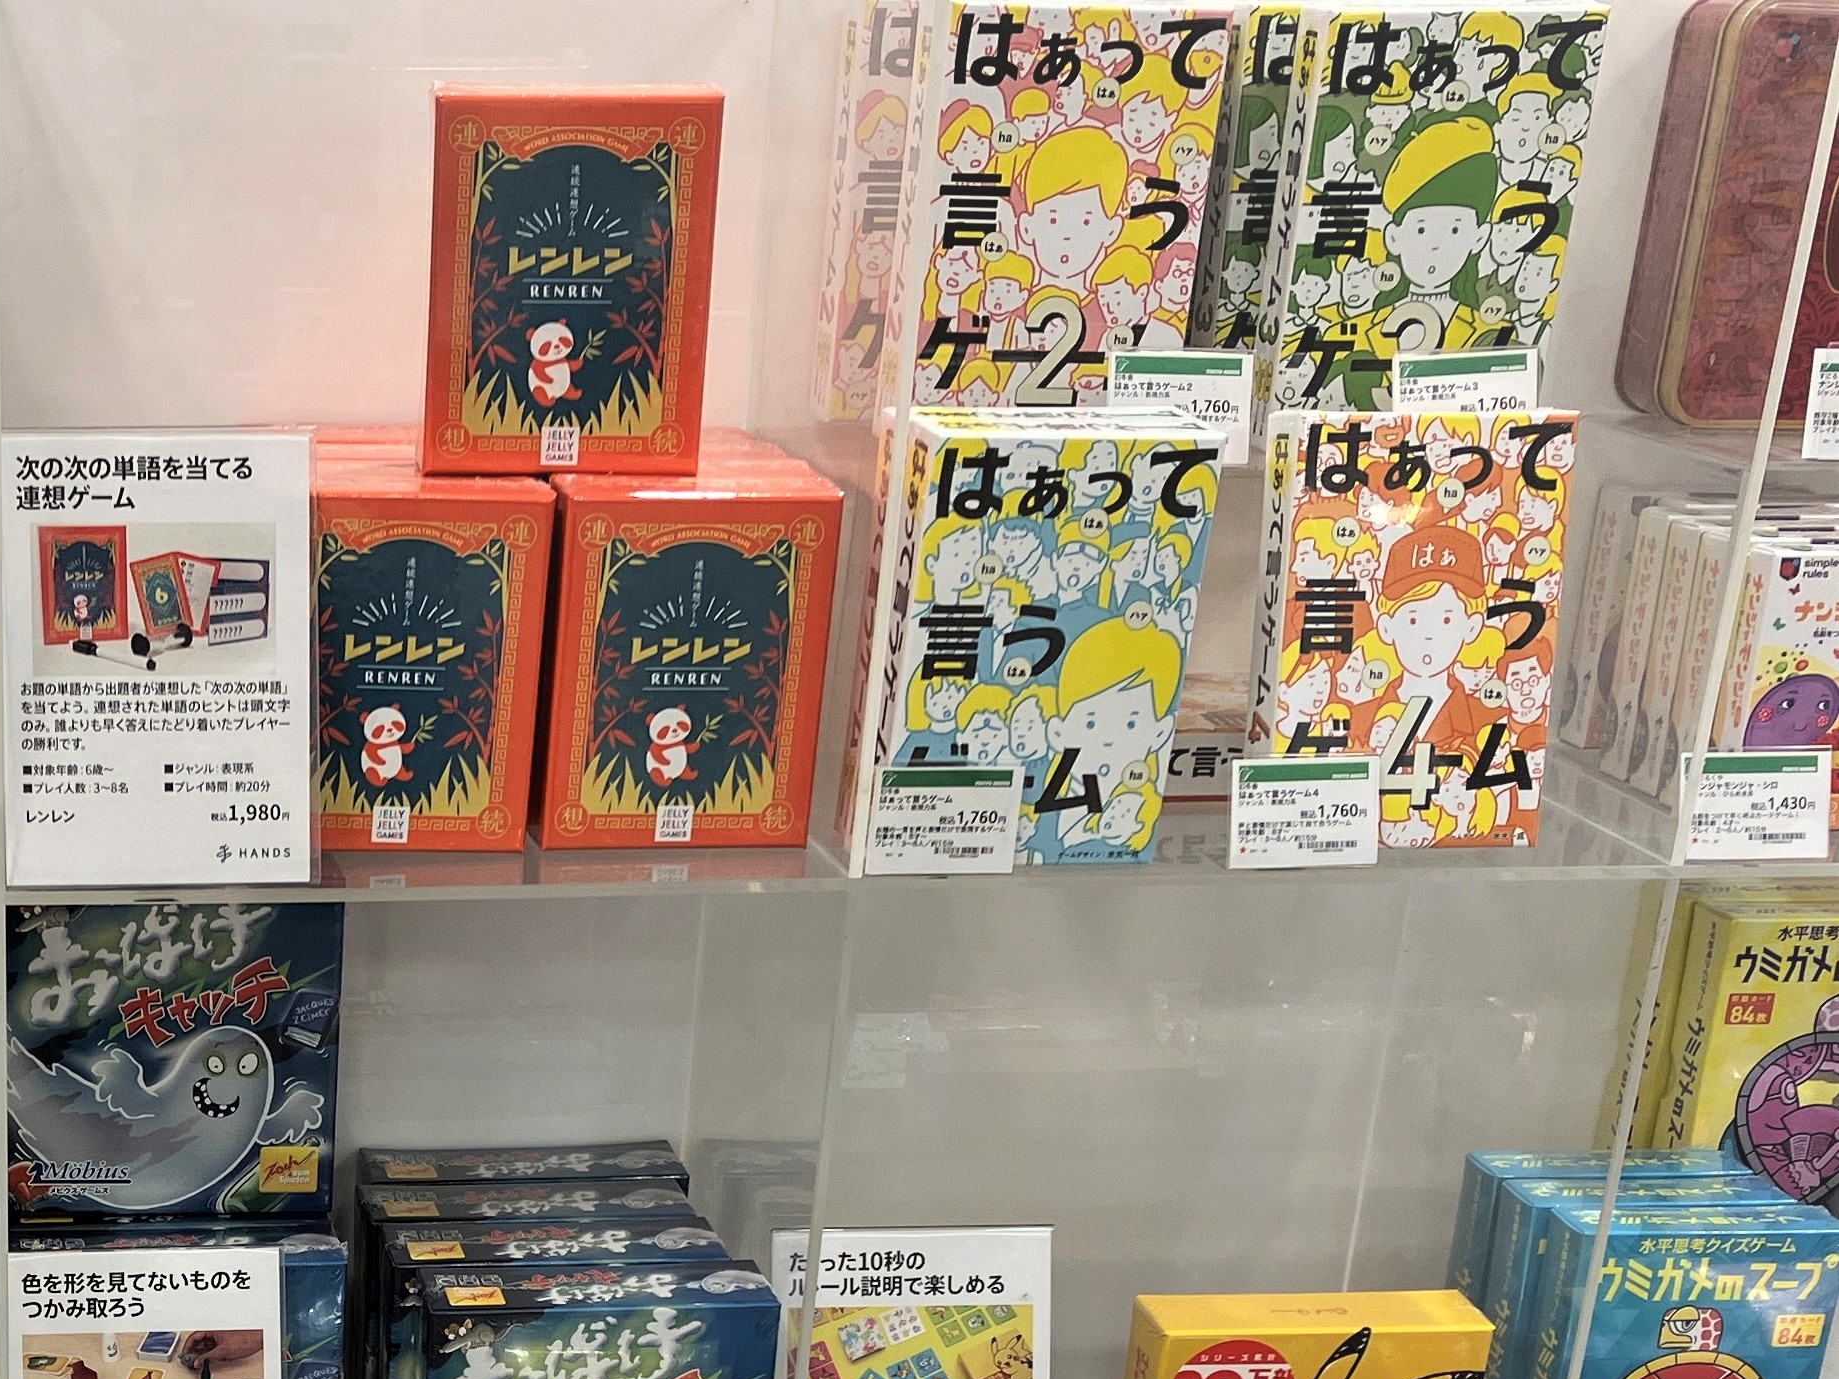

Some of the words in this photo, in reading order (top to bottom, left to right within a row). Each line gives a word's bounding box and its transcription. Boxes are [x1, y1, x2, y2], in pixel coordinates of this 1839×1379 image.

[953, 12, 1233, 89] はぁって
[1328, 10, 1608, 95] はぁって
[524, 132, 556, 152] WORD
[556, 130, 604, 147] ASSOCIATION
[605, 137, 630, 154] GAME
[508, 246, 635, 276] レンレン
[529, 284, 604, 300] RENREN
[1461, 398, 1526, 412] 税込1,760円
[546, 429, 575, 441] JELLY
[545, 441, 575, 452] JELLY
[545, 451, 575, 464] GAMES
[1303, 421, 1574, 494] はぁって
[16, 456, 253, 481] 次の次の単語を当てる
[936, 446, 1219, 520] はぁって
[16, 487, 136, 510] 連想ゲーム
[343, 635, 466, 665] レンレン
[631, 636, 753, 665] レンレン
[21, 682, 288, 697] お題の単語から出題者が連想した「次の次の単語」
[365, 671, 437, 687] RENREN
[651, 672, 723, 688] RENREN
[21, 699, 291, 714] を当てよう。連想された単語のヒントは頭文字
[21, 718, 291, 733] のみ。誰よりも早く答えにたどり着いたプレイヤー
[21, 737, 87, 751] の勝利です。
[26, 809, 75, 823] レンレン
[211, 804, 290, 823] 税込1,980円
[1300, 804, 1367, 819] 税込1,760円
[1751, 796, 1816, 811] 税込1,430円
[939, 811, 1006, 825] 税込1,760円
[239, 847, 291, 858] HANDS
[120, 957, 289, 1047] キャッチ
[1639, 1235, 1796, 1256] 水平思考クイズゲーム
[789, 1251, 925, 1272] たった10秒の
[22, 1270, 251, 1294] 色を形を見てないものを
[788, 1275, 1005, 1297] ルール説明で楽しめる
[1597, 1253, 1839, 1302] ウミガメのスープ
[24, 1298, 144, 1319] つかみ取ろう
